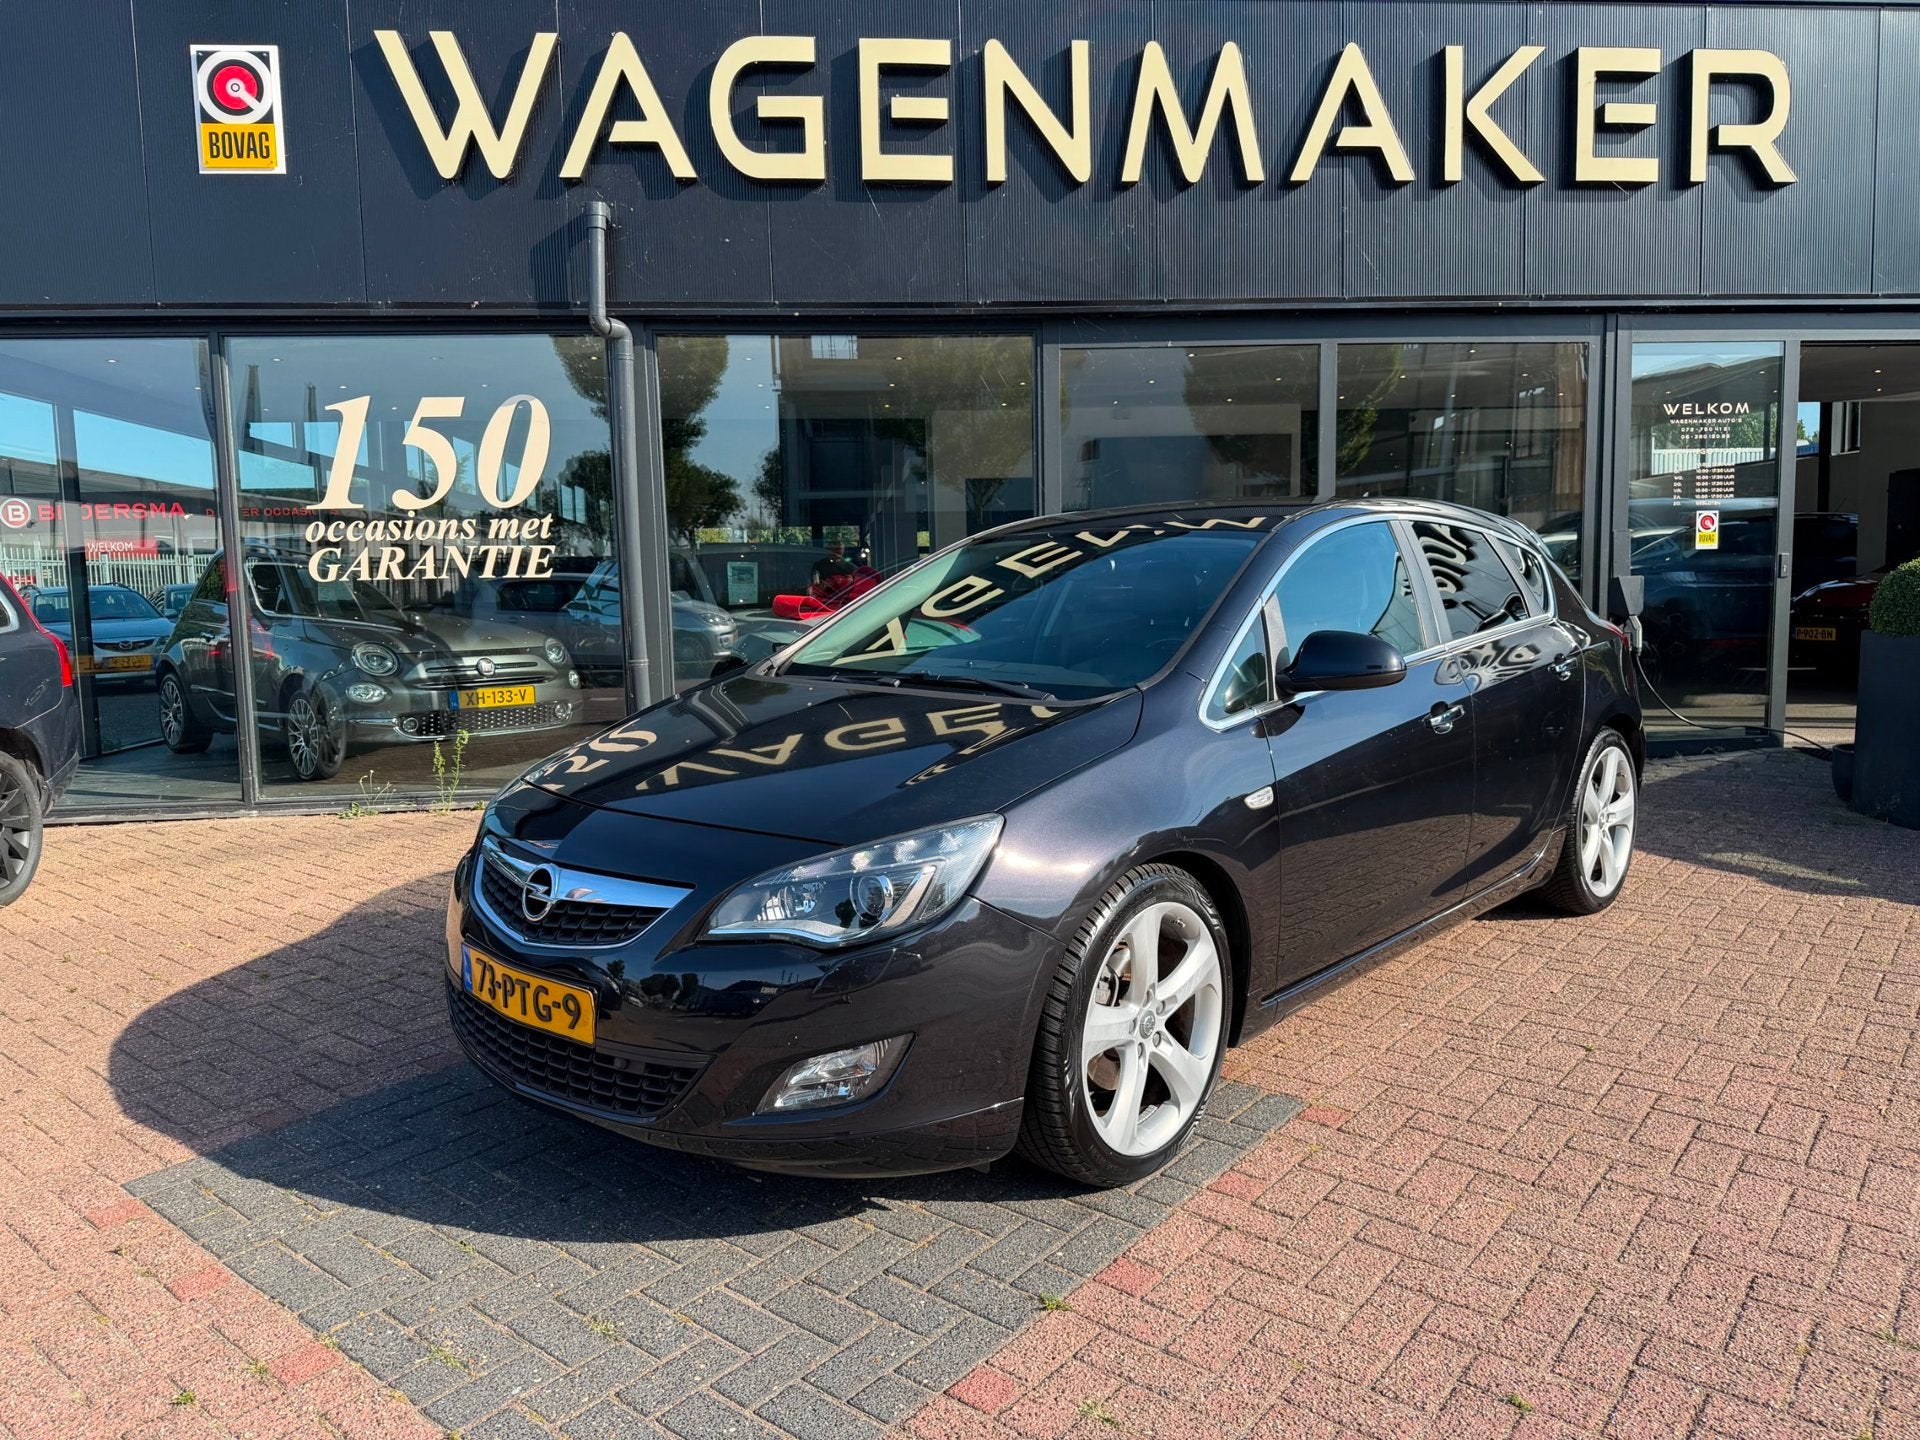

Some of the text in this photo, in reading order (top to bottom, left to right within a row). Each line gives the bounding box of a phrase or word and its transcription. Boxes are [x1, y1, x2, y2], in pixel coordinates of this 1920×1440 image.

[374, 30, 1798, 183] WAGENMAKER
[208, 131, 270, 160] BOVAG
[1663, 402, 1750, 415] WELKOM
[306, 394, 551, 510] 150
[37, 502, 186, 521] BIDERSMA
[305, 510, 553, 543] occasions met
[86, 541, 133, 552] WELKOM
[308, 545, 556, 582] GARANTIE
[465, 689, 527, 706] XH-133-V
[475, 957, 581, 1030] 73-PTG-9
